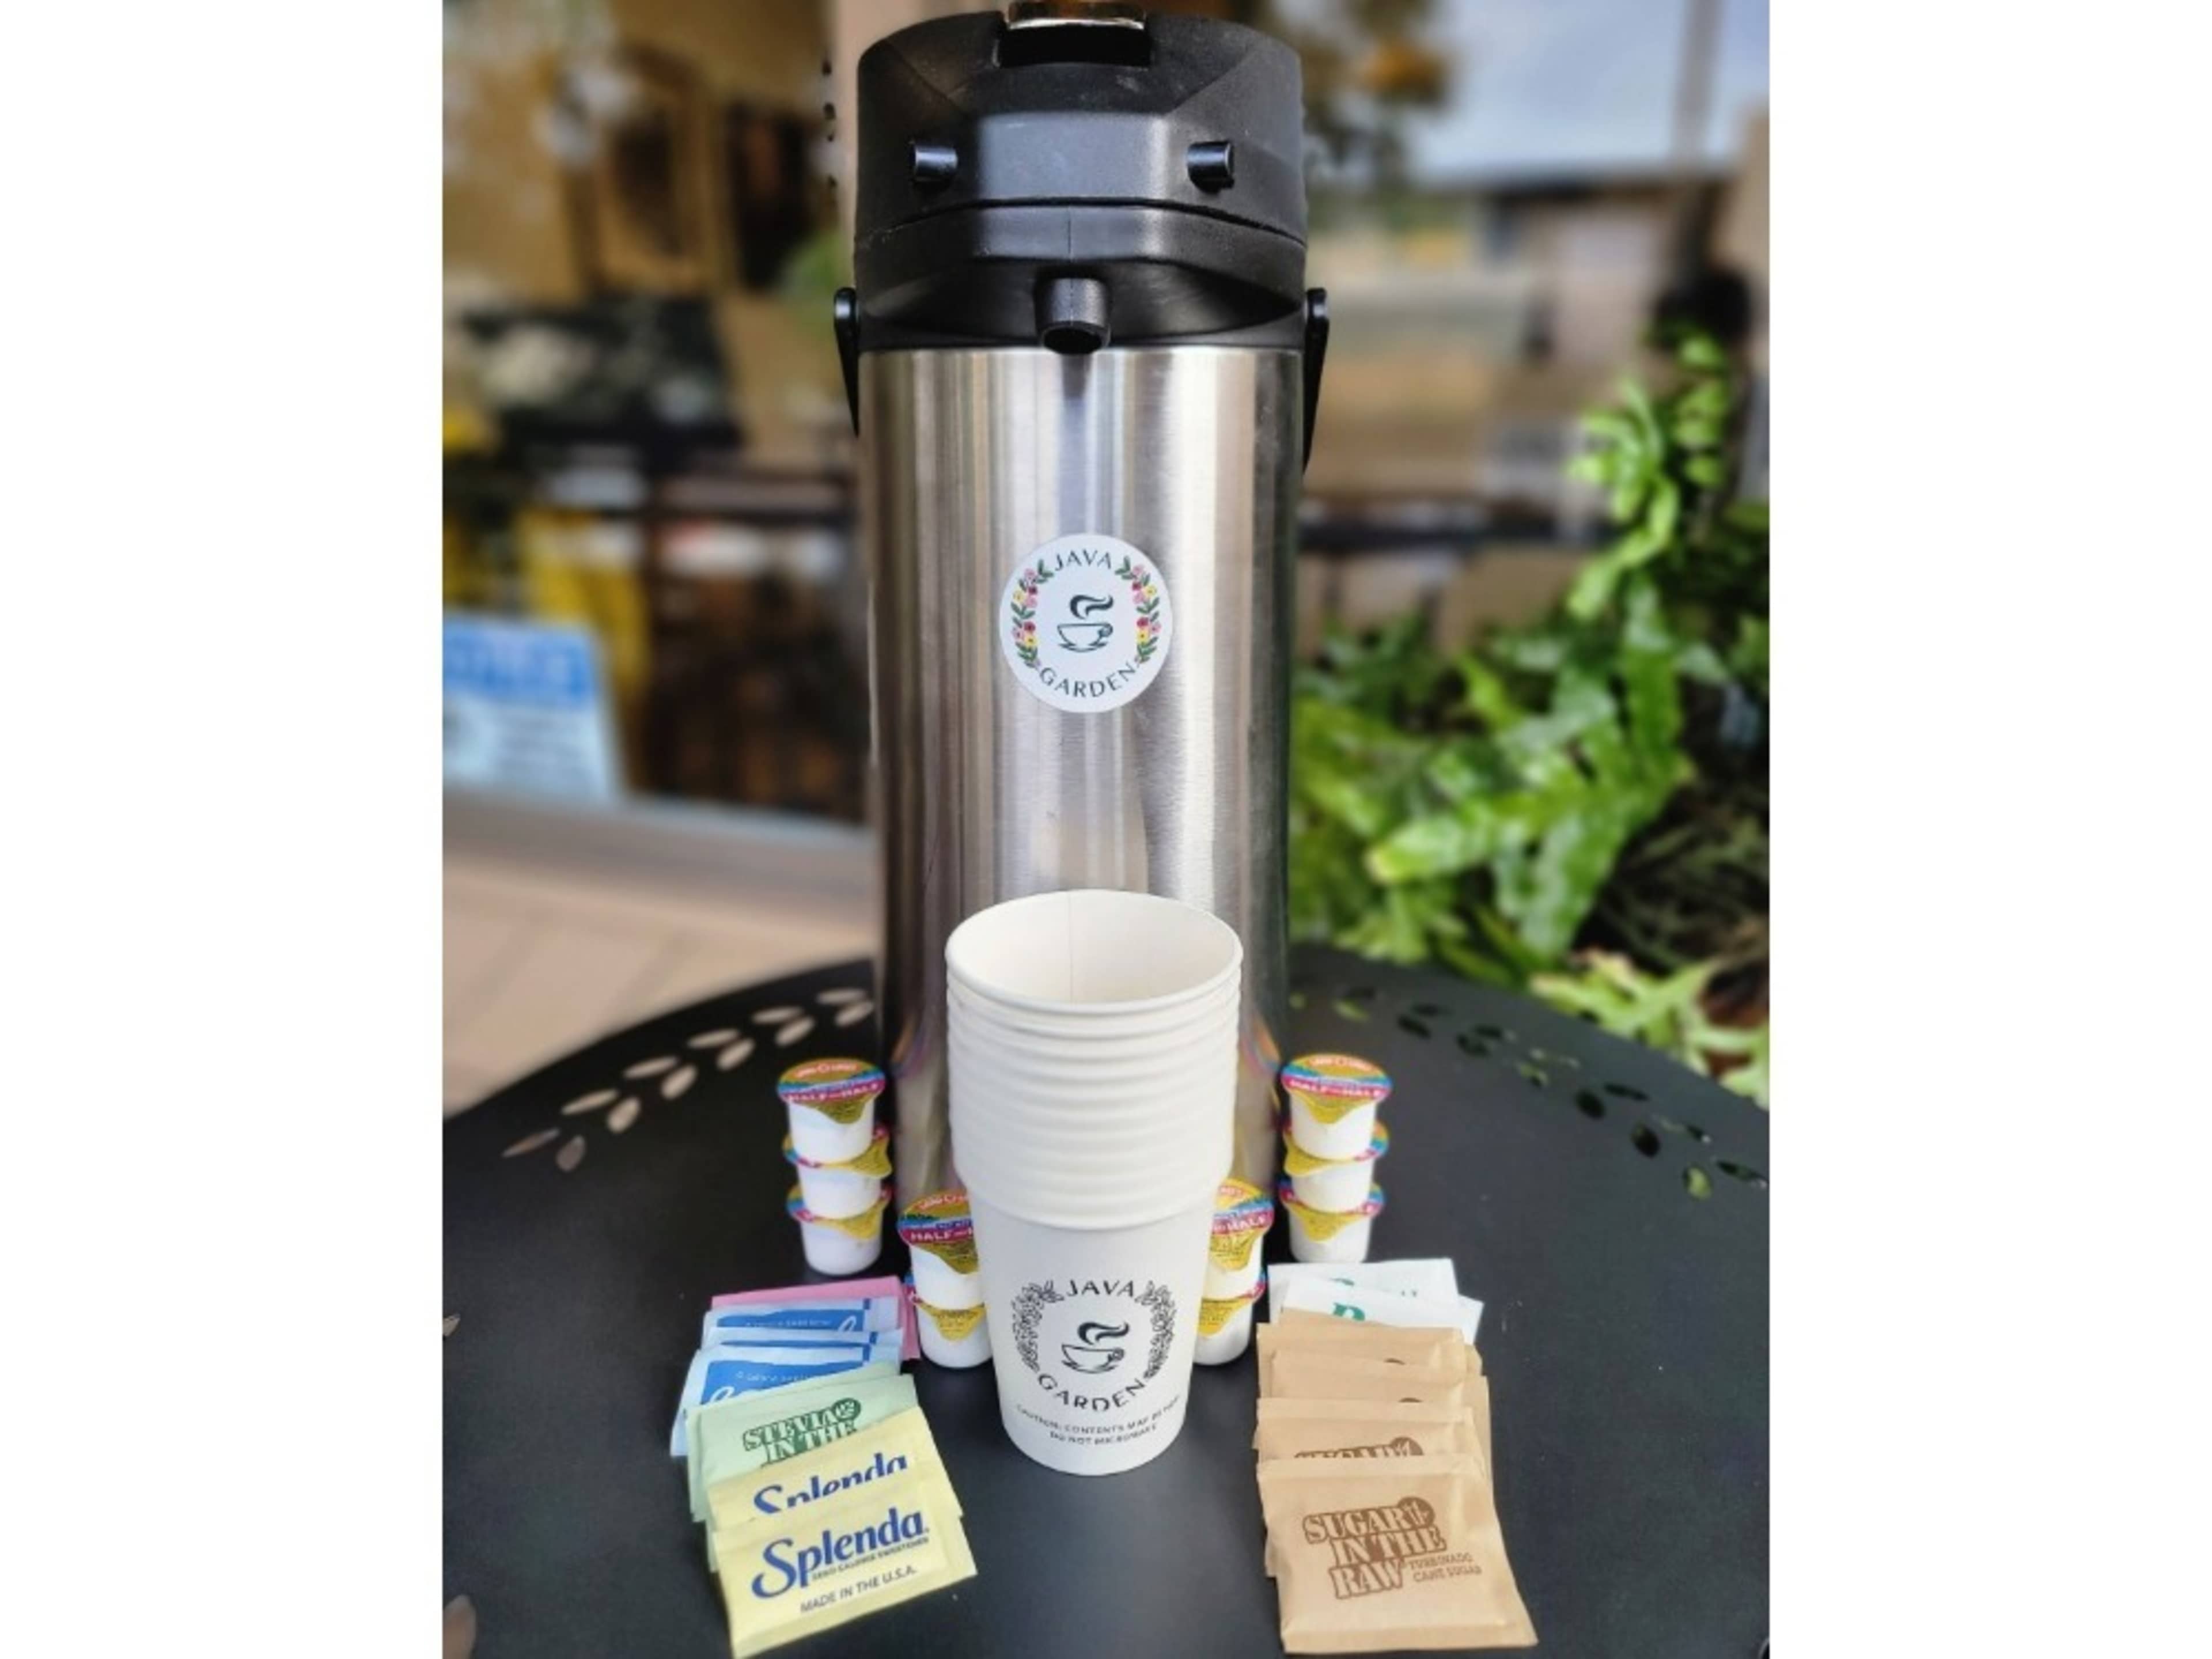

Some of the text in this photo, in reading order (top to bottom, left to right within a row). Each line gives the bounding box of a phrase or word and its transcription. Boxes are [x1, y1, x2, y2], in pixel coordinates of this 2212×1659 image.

[1055, 550, 1112, 571] JAVA
[1039, 662, 1137, 698] GARDEN
[1066, 1279, 1134, 1298] JAVA
[1037, 1373, 1146, 1412] GARDEN
[742, 1407, 839, 1452] STEVIA
[760, 1418, 857, 1467] IN THE
[1302, 1506, 1411, 1545] SUGAR
[751, 1506, 924, 1599] Splenda
[1328, 1524, 1448, 1567] IN THE
[800, 1593, 838, 1612] MADE
[839, 1585, 854, 1600] IN
[856, 1575, 880, 1593] THE
[1328, 1555, 1404, 1600] RAW
